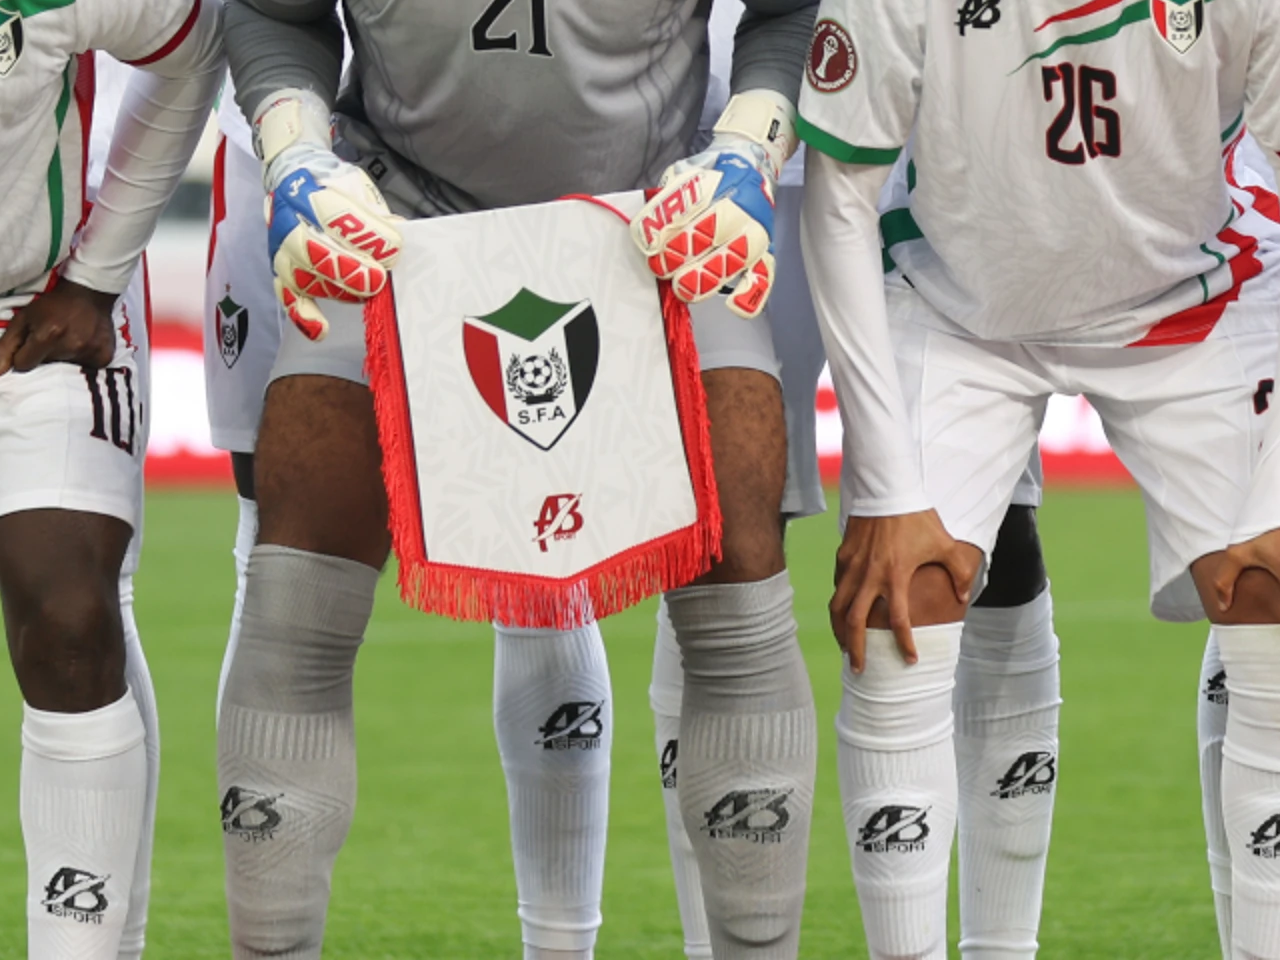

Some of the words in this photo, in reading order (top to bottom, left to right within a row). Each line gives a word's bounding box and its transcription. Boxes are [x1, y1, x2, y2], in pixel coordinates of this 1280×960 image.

[1041, 61, 1122, 166] 26
[328, 213, 399, 261] RIN
[642, 175, 700, 244] NAT
[79, 365, 135, 456] 10
[518, 404, 567, 425] S.F.A
